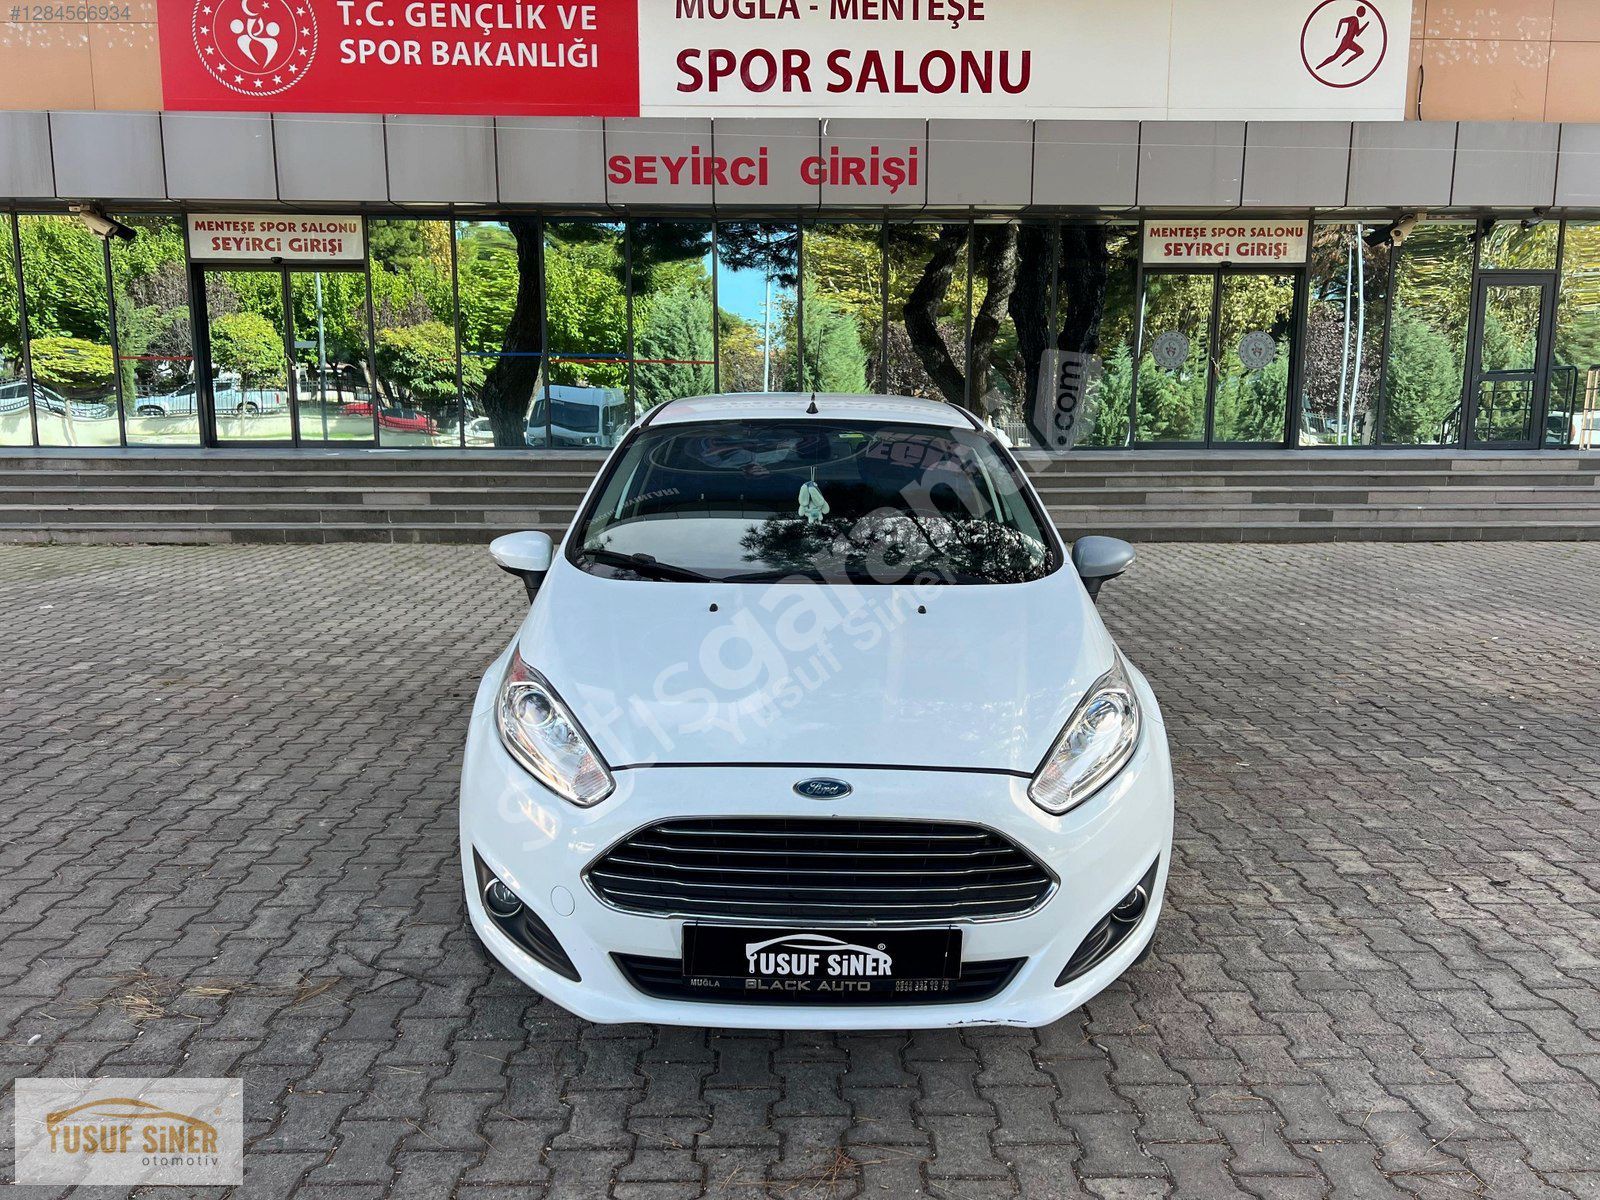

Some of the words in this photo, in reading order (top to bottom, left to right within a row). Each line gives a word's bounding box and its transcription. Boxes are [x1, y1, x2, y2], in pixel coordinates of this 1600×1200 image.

[336, 1, 395, 26] T.C.
[404, 0, 547, 35] GENÇLİK
[557, 5, 598, 30] VE
[829, 0, 985, 29] MENTEŞE
[339, 38, 423, 65] SPOR
[431, 37, 599, 68] BAKANLIĞI
[675, 48, 812, 93] SPOR
[826, 49, 1032, 94] SALONU
[607, 145, 769, 185] SEYİRCİ
[799, 146, 918, 195] GİRİŞİ
[194, 220, 256, 235] MENTEŞE
[259, 221, 297, 233] SPOR
[301, 222, 357, 234] SALONU
[1149, 227, 1207, 240] MENTEŞE
[1211, 227, 1246, 238] SPOR
[1250, 227, 1304, 238] SALONU
[805, 781, 839, 795] Ford
[749, 953, 820, 976] YUSUF
[690, 979, 721, 988] MUĞLA
[745, 979, 811, 991] BLACK
[817, 980, 871, 992] AUTO
